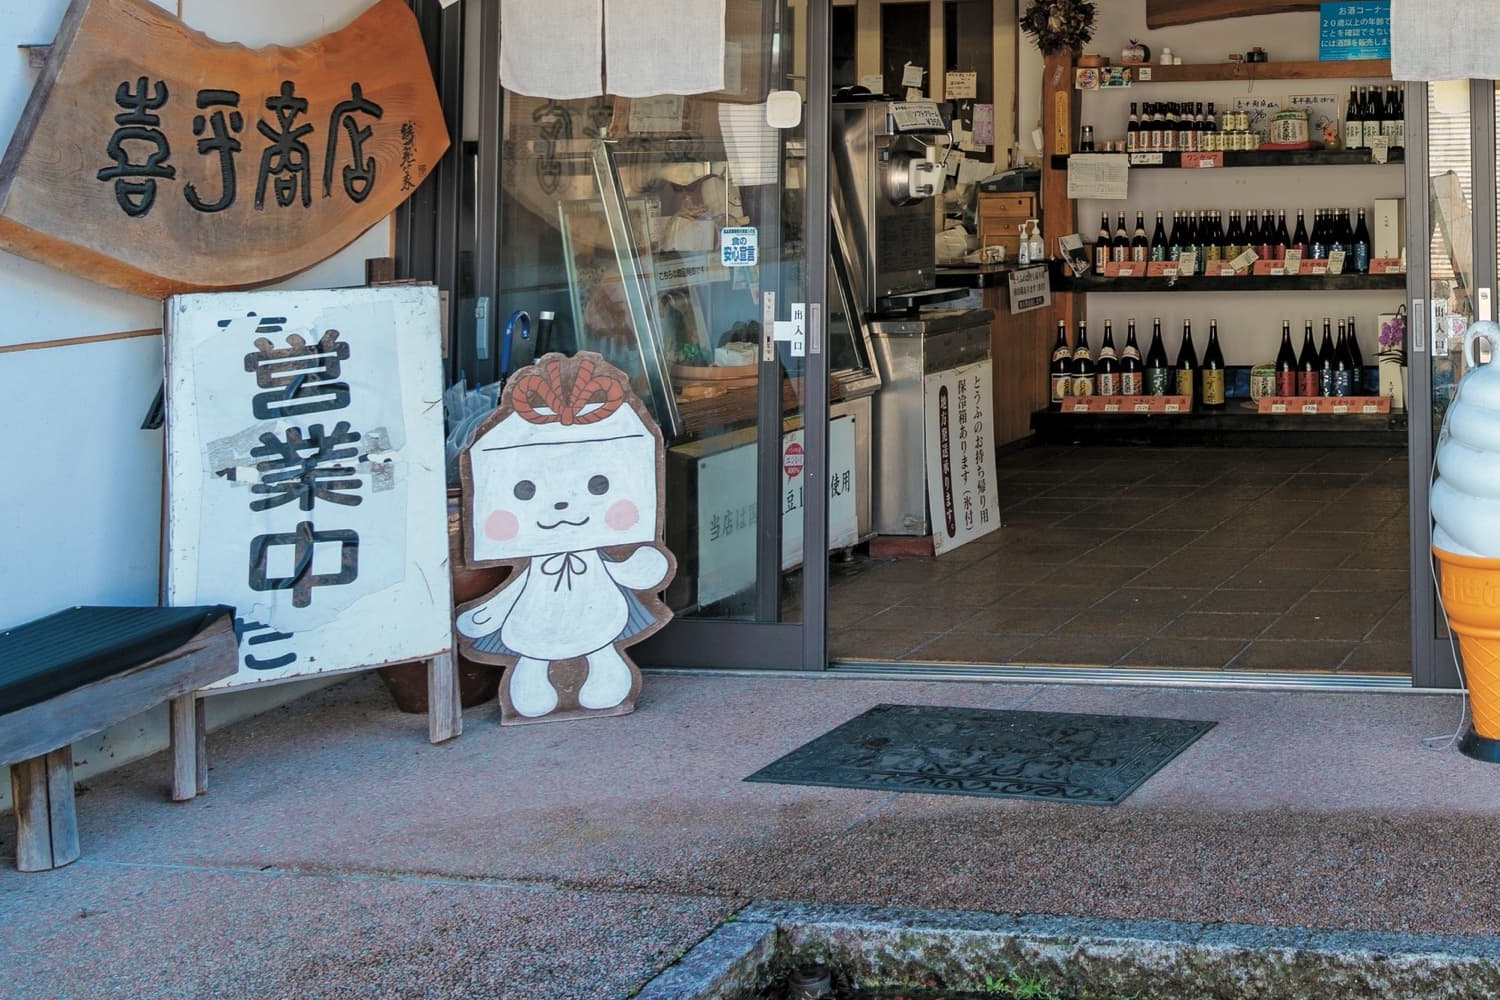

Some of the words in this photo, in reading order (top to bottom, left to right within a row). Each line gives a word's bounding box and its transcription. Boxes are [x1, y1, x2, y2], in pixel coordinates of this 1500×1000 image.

[97, 75, 384, 218] 喜平商店
[724, 245, 755, 262] 安心宣言
[731, 236, 748, 246] 食の
[794, 309, 803, 351] 出入口
[244, 326, 363, 609] 営業中
[973, 375, 989, 524] とうふのお持ち帰り用
[831, 469, 850, 498] 使用
